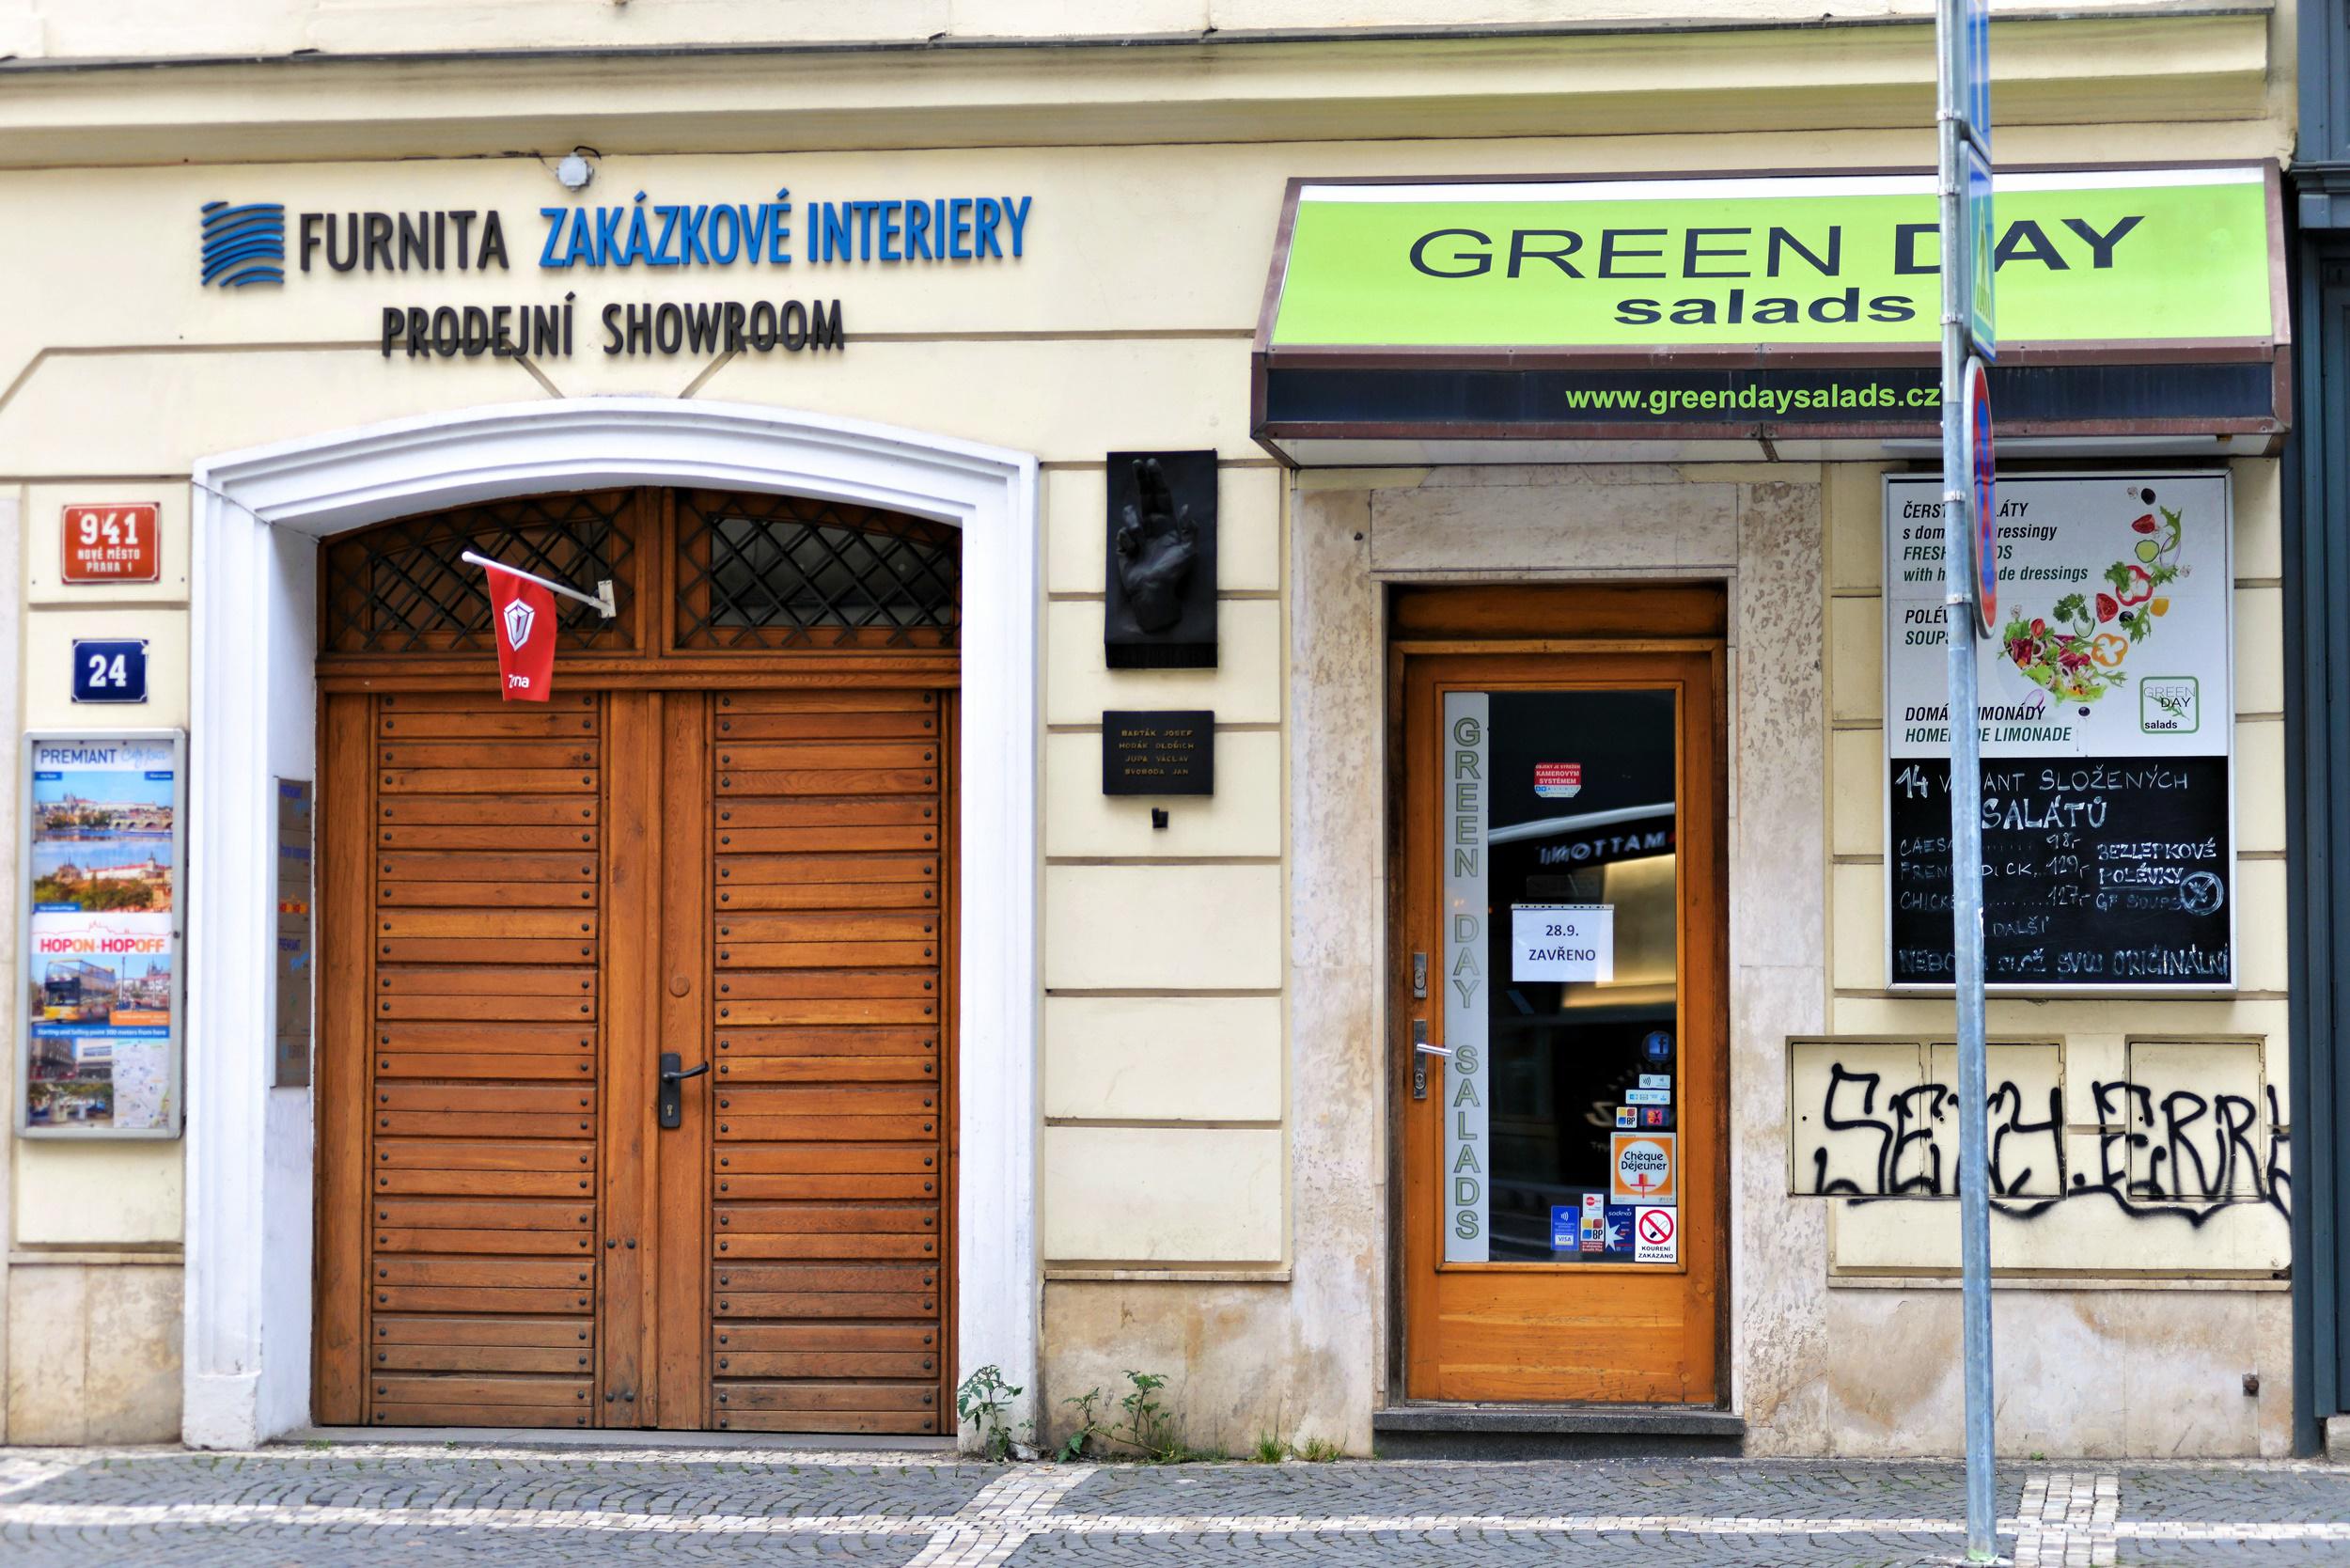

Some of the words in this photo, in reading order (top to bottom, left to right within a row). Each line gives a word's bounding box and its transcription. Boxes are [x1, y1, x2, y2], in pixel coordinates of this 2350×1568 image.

[299, 208, 510, 274] FURNITA
[538, 189, 792, 271] ZAKÁZKOVÉ
[807, 195, 1033, 265] INTERIERY
[1408, 226, 1842, 280] GREEN
[1894, 215, 2145, 276] DAY
[1613, 288, 1917, 324] salads
[381, 291, 577, 358] PRODEJNÍ
[602, 298, 846, 355] SHOWROOM
[1564, 382, 1941, 415] www.greendaysalads.cz
[1904, 500, 1946, 518] ČERST
[80, 512, 138, 545] 941
[1903, 527, 1911, 540] s
[1997, 524, 2058, 541] ressingy
[78, 547, 103, 559] NOVÉ
[107, 546, 140, 559] MĚSTO
[86, 562, 120, 572] PRAHA
[128, 562, 133, 572] 1
[1904, 567, 1934, 582] with
[2020, 566, 2089, 583] dressings
[1904, 605, 1948, 624] POLÉ
[1904, 630, 1949, 645] SOUP
[88, 654, 127, 687] 24
[2144, 686, 2196, 697] GREEN
[1904, 702, 1950, 721] DOMÁ
[1978, 702, 2046, 721] IMONÁDY
[2161, 698, 2191, 708] DAY
[2144, 719, 2178, 729] salads
[1994, 727, 2073, 742] LIMONADE
[40, 748, 118, 764] PREMIANT
[1895, 764, 1929, 799] 14
[1939, 772, 2026, 793] VANT
[2039, 763, 2189, 792] SLOŽENÝCH
[1453, 716, 1481, 877] GREEN
[1981, 795, 2107, 830] SALÁTŮ
[1900, 837, 1953, 857] CAES
[2097, 837, 2217, 860] BEZLEPKOVÉ
[1900, 861, 1954, 881] FREN
[2099, 862, 2184, 886] POLÉVKY
[1900, 891, 1955, 911] CHICK
[1545, 924, 1579, 937] 28.9.
[1452, 914, 1480, 1009] DAY
[1528, 946, 1596, 963] ZAVŘENO
[1453, 1045, 1481, 1240] SALADS
[1621, 1160, 1668, 1172] Déjeuner
[1623, 1151, 1664, 1162] Chèque
[1592, 1229, 1604, 1240] BP
